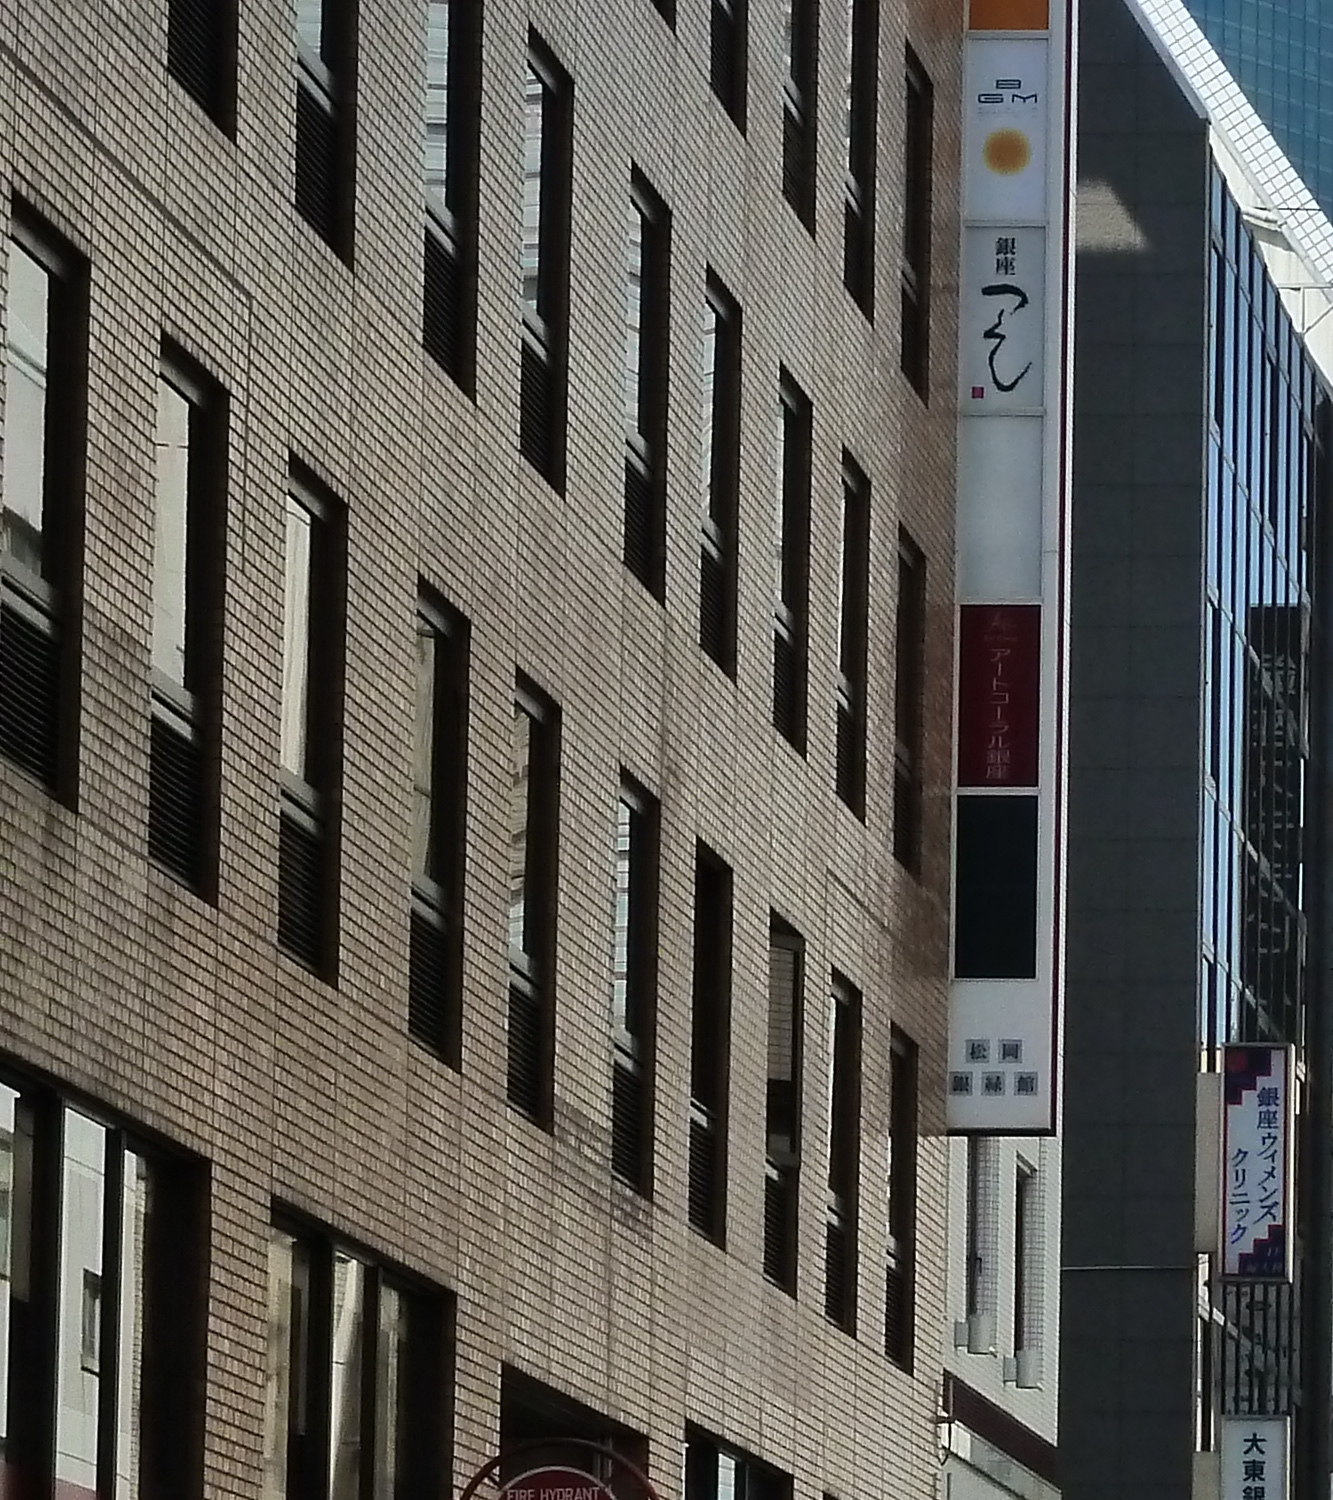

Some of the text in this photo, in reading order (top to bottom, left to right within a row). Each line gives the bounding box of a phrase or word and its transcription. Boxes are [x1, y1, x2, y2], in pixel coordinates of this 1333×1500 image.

[995, 237, 1016, 276] 銀座
[1229, 1148, 1249, 1245] クリニック
[1254, 1086, 1280, 1225] 銀座ウィメンズ
